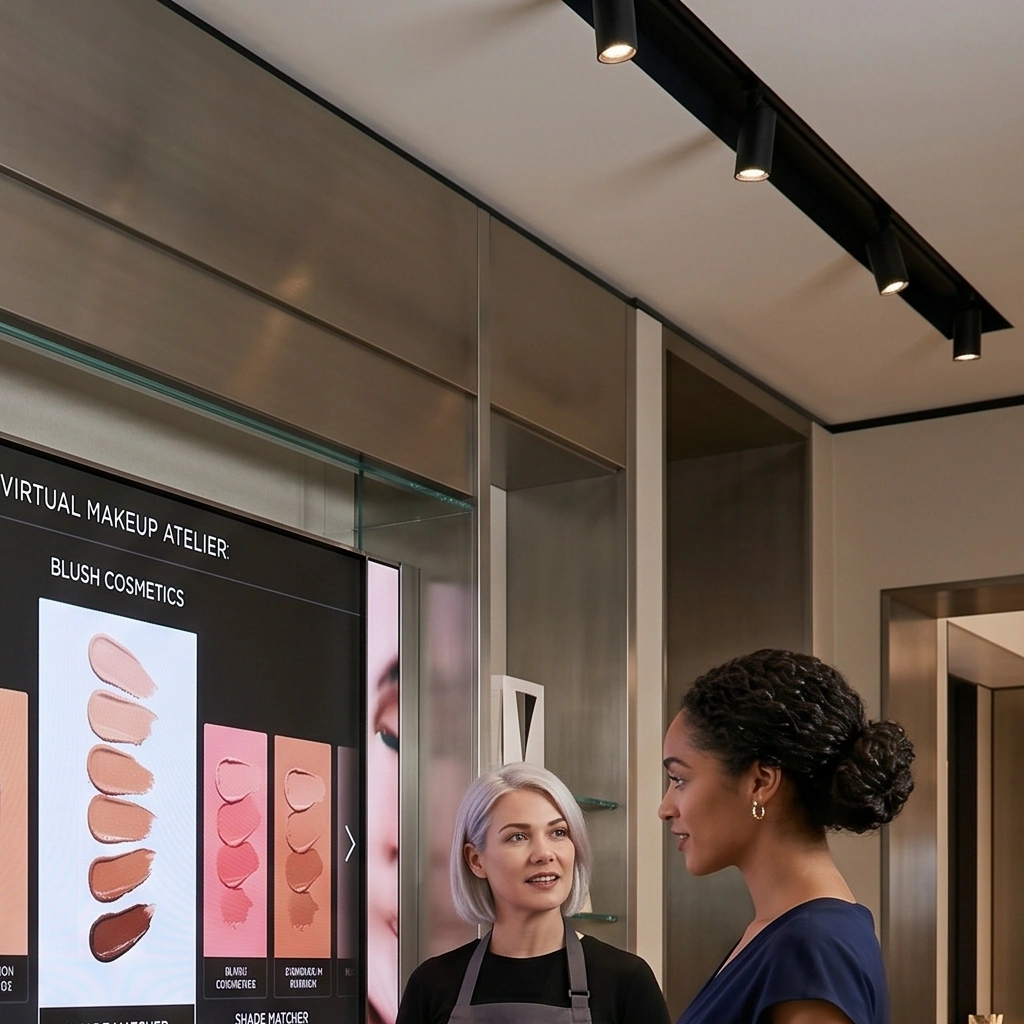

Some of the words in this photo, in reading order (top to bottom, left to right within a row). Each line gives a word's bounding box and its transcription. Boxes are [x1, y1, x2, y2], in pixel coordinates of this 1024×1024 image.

[0, 473, 81, 517] VIRTUAL
[87, 500, 158, 538] MAKEUP
[163, 523, 230, 560] ATELIER:
[51, 557, 100, 586] BLUSH
[104, 570, 185, 607] COSMETICS
